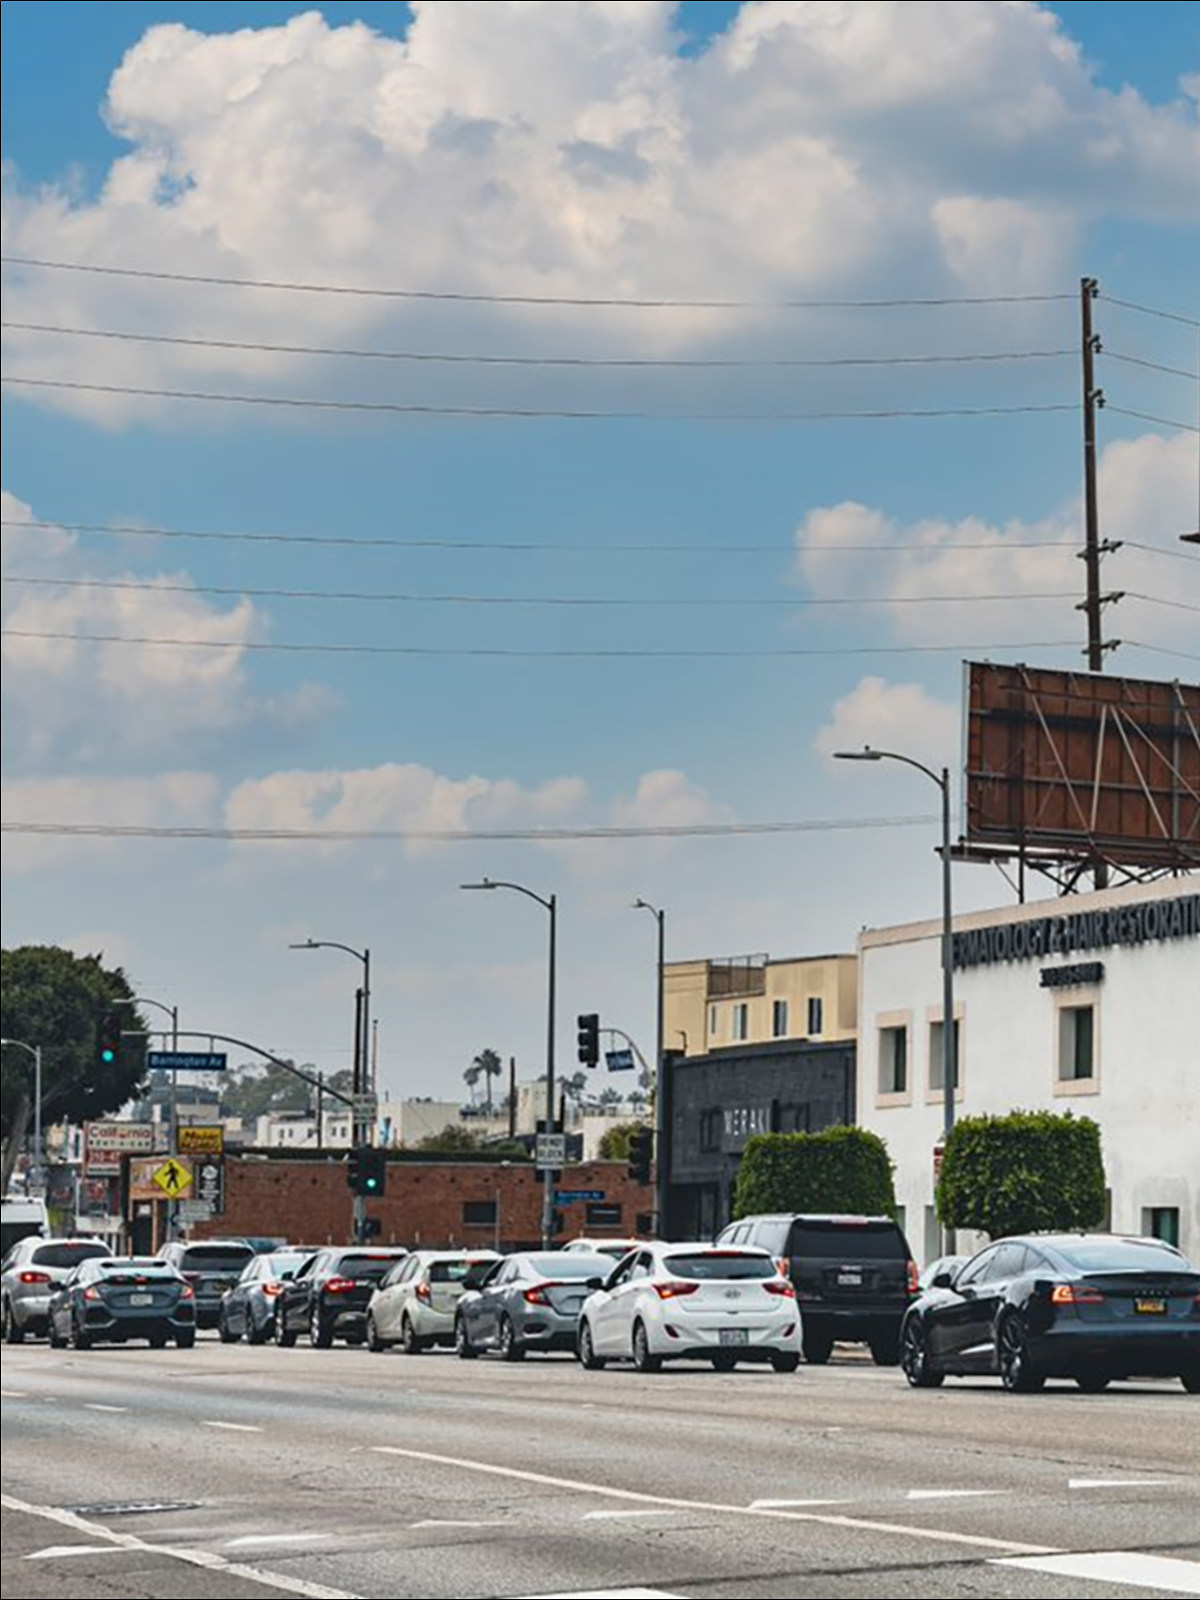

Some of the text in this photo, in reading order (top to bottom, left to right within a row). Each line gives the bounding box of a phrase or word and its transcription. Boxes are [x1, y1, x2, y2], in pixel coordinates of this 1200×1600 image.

[945, 917, 1049, 968] ERMATOLOGY
[1051, 916, 1066, 951] &
[1066, 913, 1104, 949] HAIR
[151, 1054, 207, 1067] Barrington
